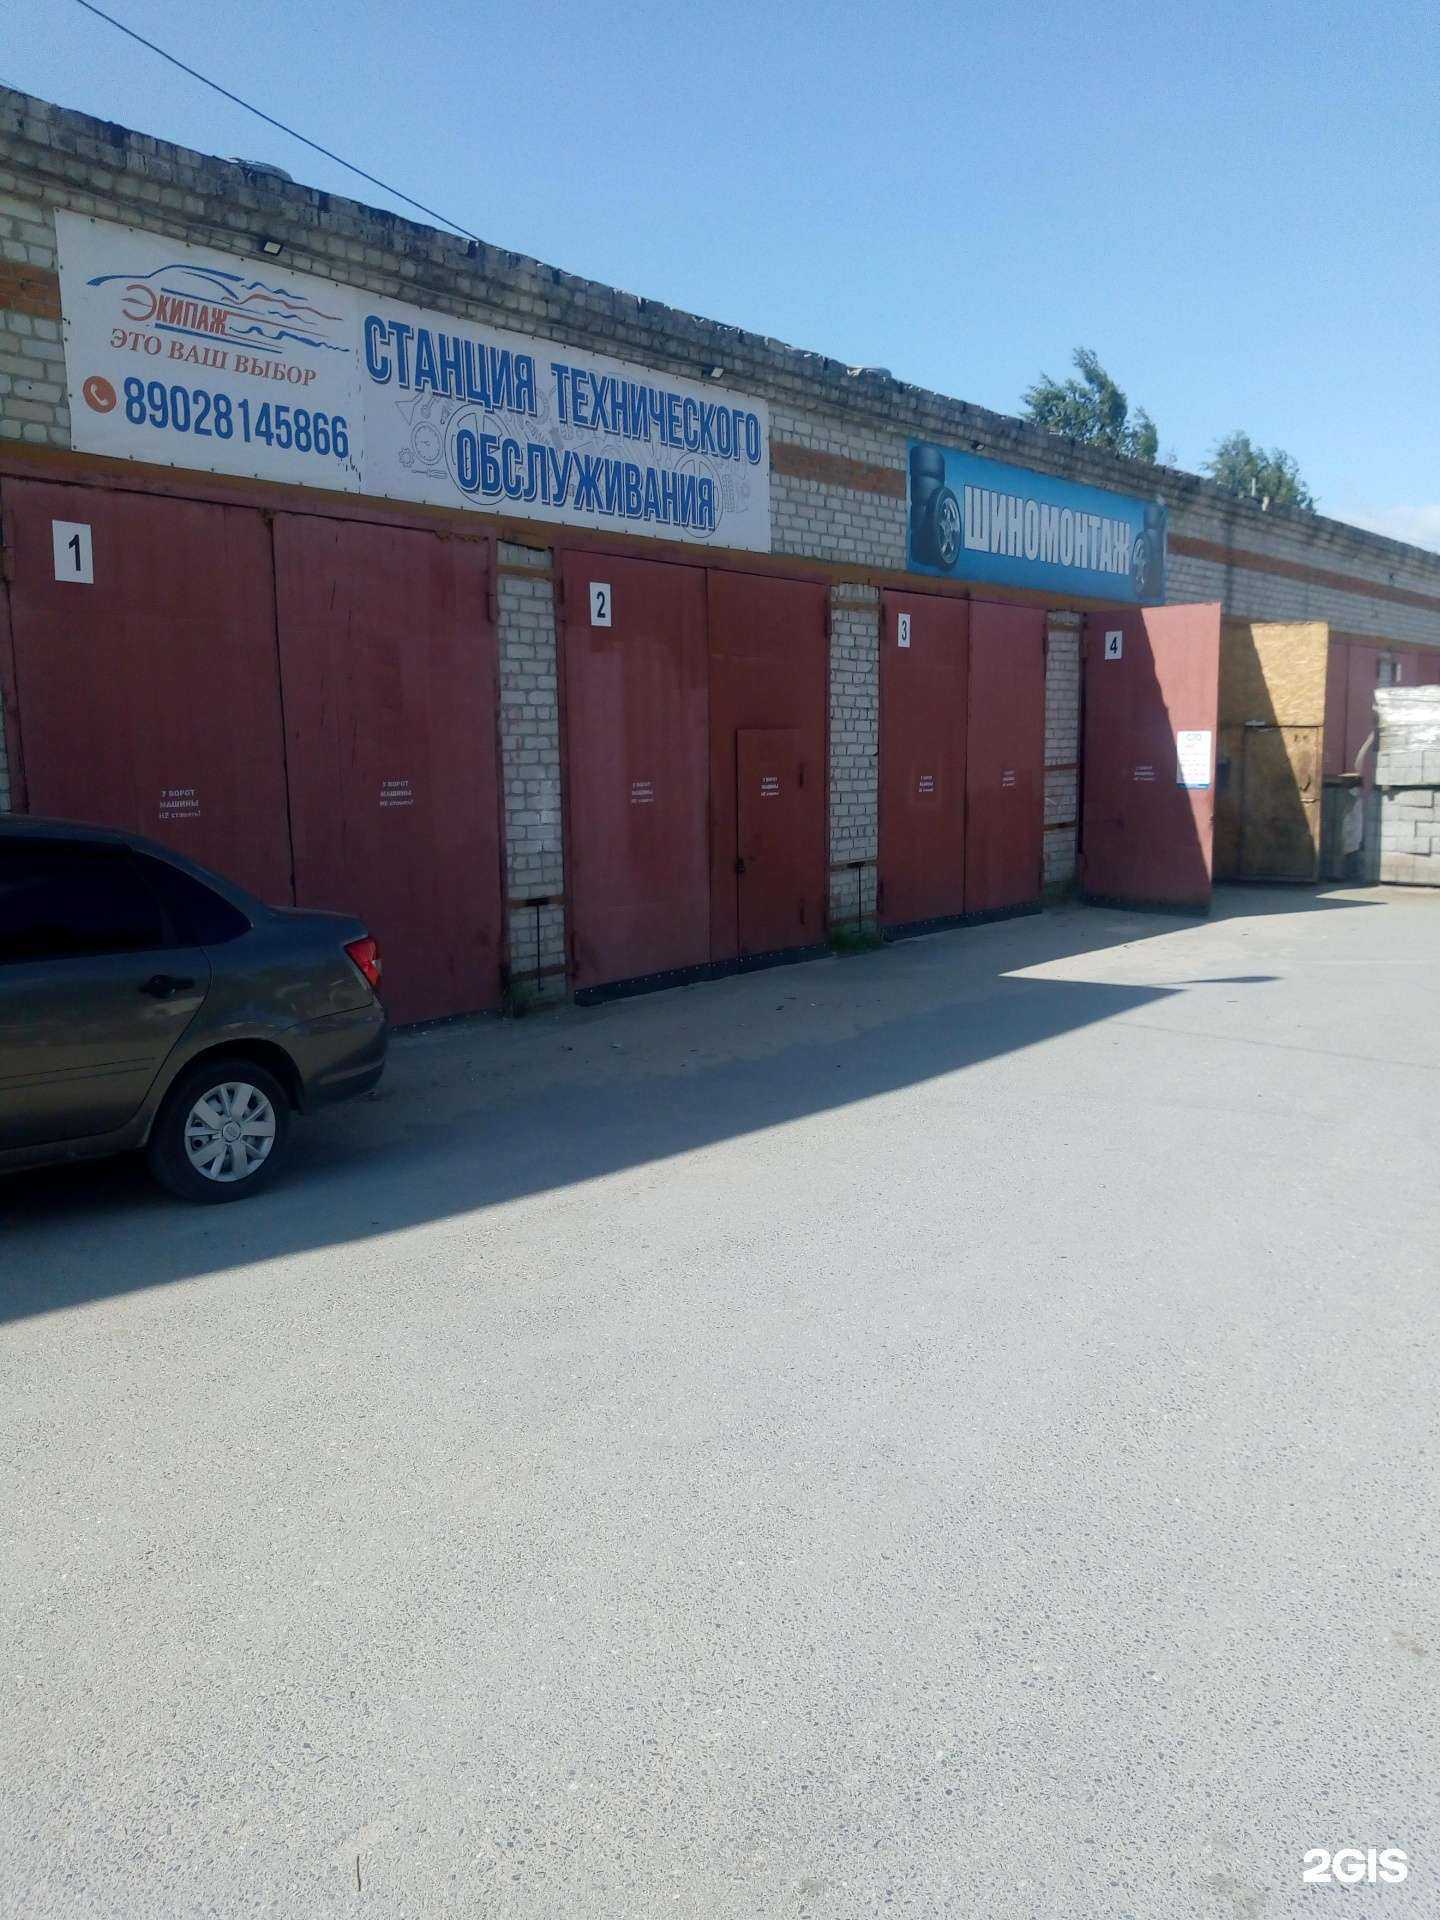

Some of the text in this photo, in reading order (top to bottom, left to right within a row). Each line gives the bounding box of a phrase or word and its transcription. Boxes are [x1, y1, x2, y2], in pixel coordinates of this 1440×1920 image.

[121, 284, 229, 336] ЭКИПАЖ
[110, 328, 317, 386] ЭТО ВАШ ВЫБОР
[123, 376, 350, 459] 89028145866
[364, 315, 762, 465] СТАНЦИЯ ТЕХНИЧЕСКОГО
[456, 428, 716, 532] ОБСЛУЖИВАНИЯ
[68, 533, 81, 572] 1
[964, 484, 1131, 576] ШИНОМОНТАЖ
[596, 591, 606, 619] 2
[901, 619, 907, 641] 3
[1109, 636, 1119, 654] 4
